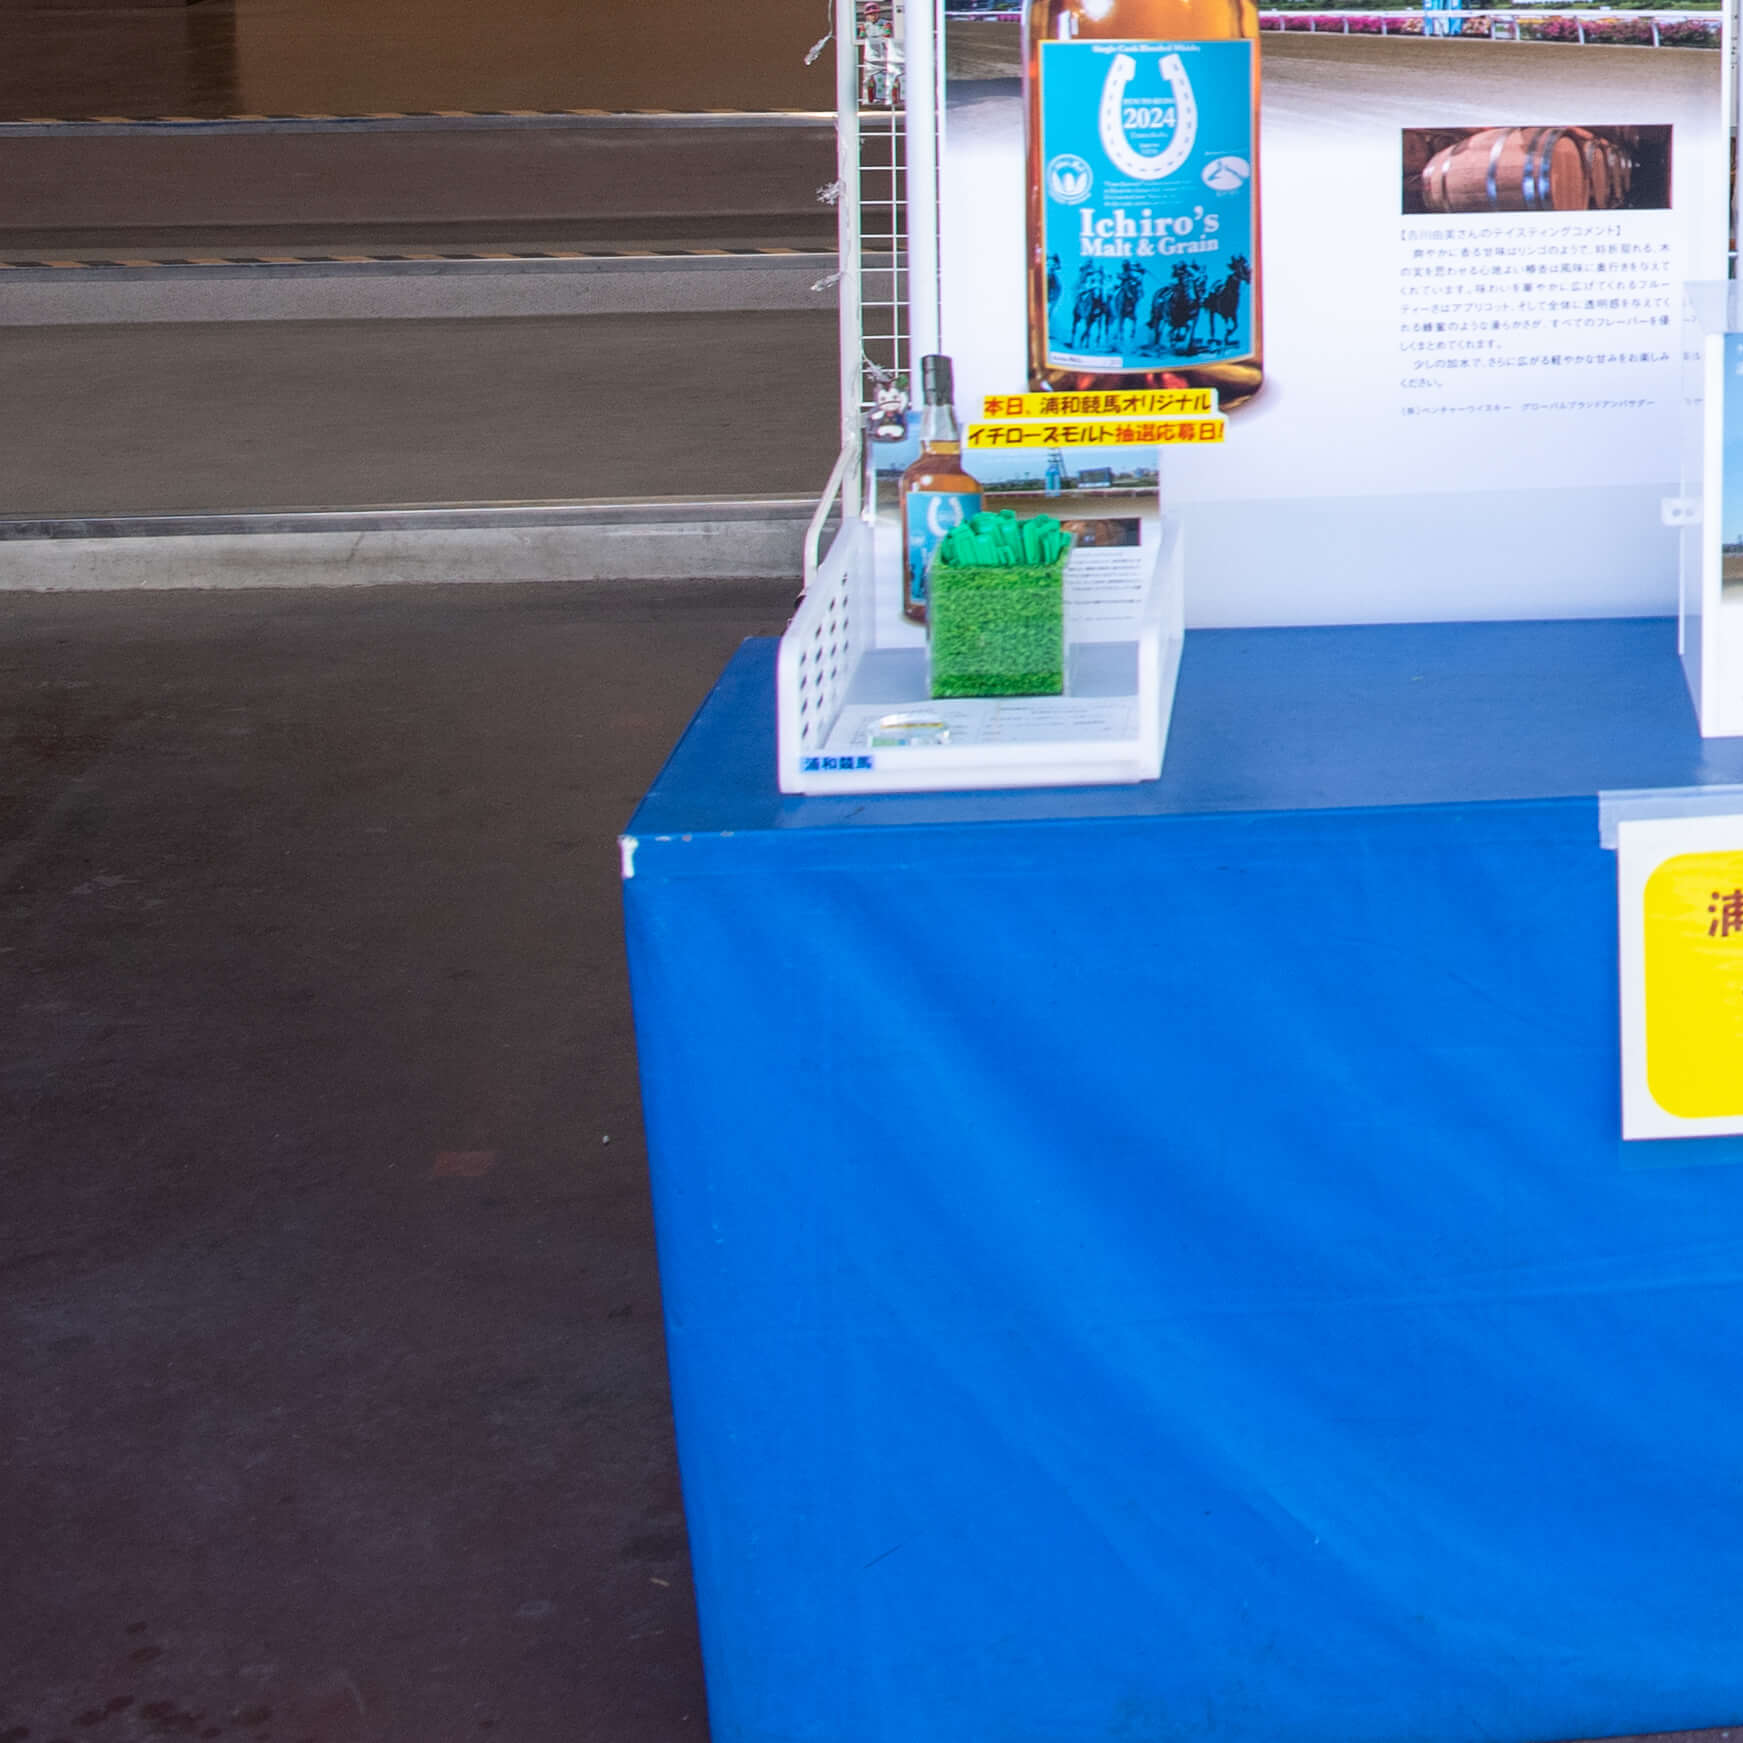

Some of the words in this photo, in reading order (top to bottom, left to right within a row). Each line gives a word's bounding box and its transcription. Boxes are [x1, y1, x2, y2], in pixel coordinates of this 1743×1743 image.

[1123, 107, 1177, 129] 2024
[1079, 205, 1220, 238] Ichiro's
[1080, 237, 1132, 257] Malt
[1136, 237, 1156, 257] &
[1157, 234, 1220, 256] Grain
[804, 756, 872, 771] 浦和競馬
